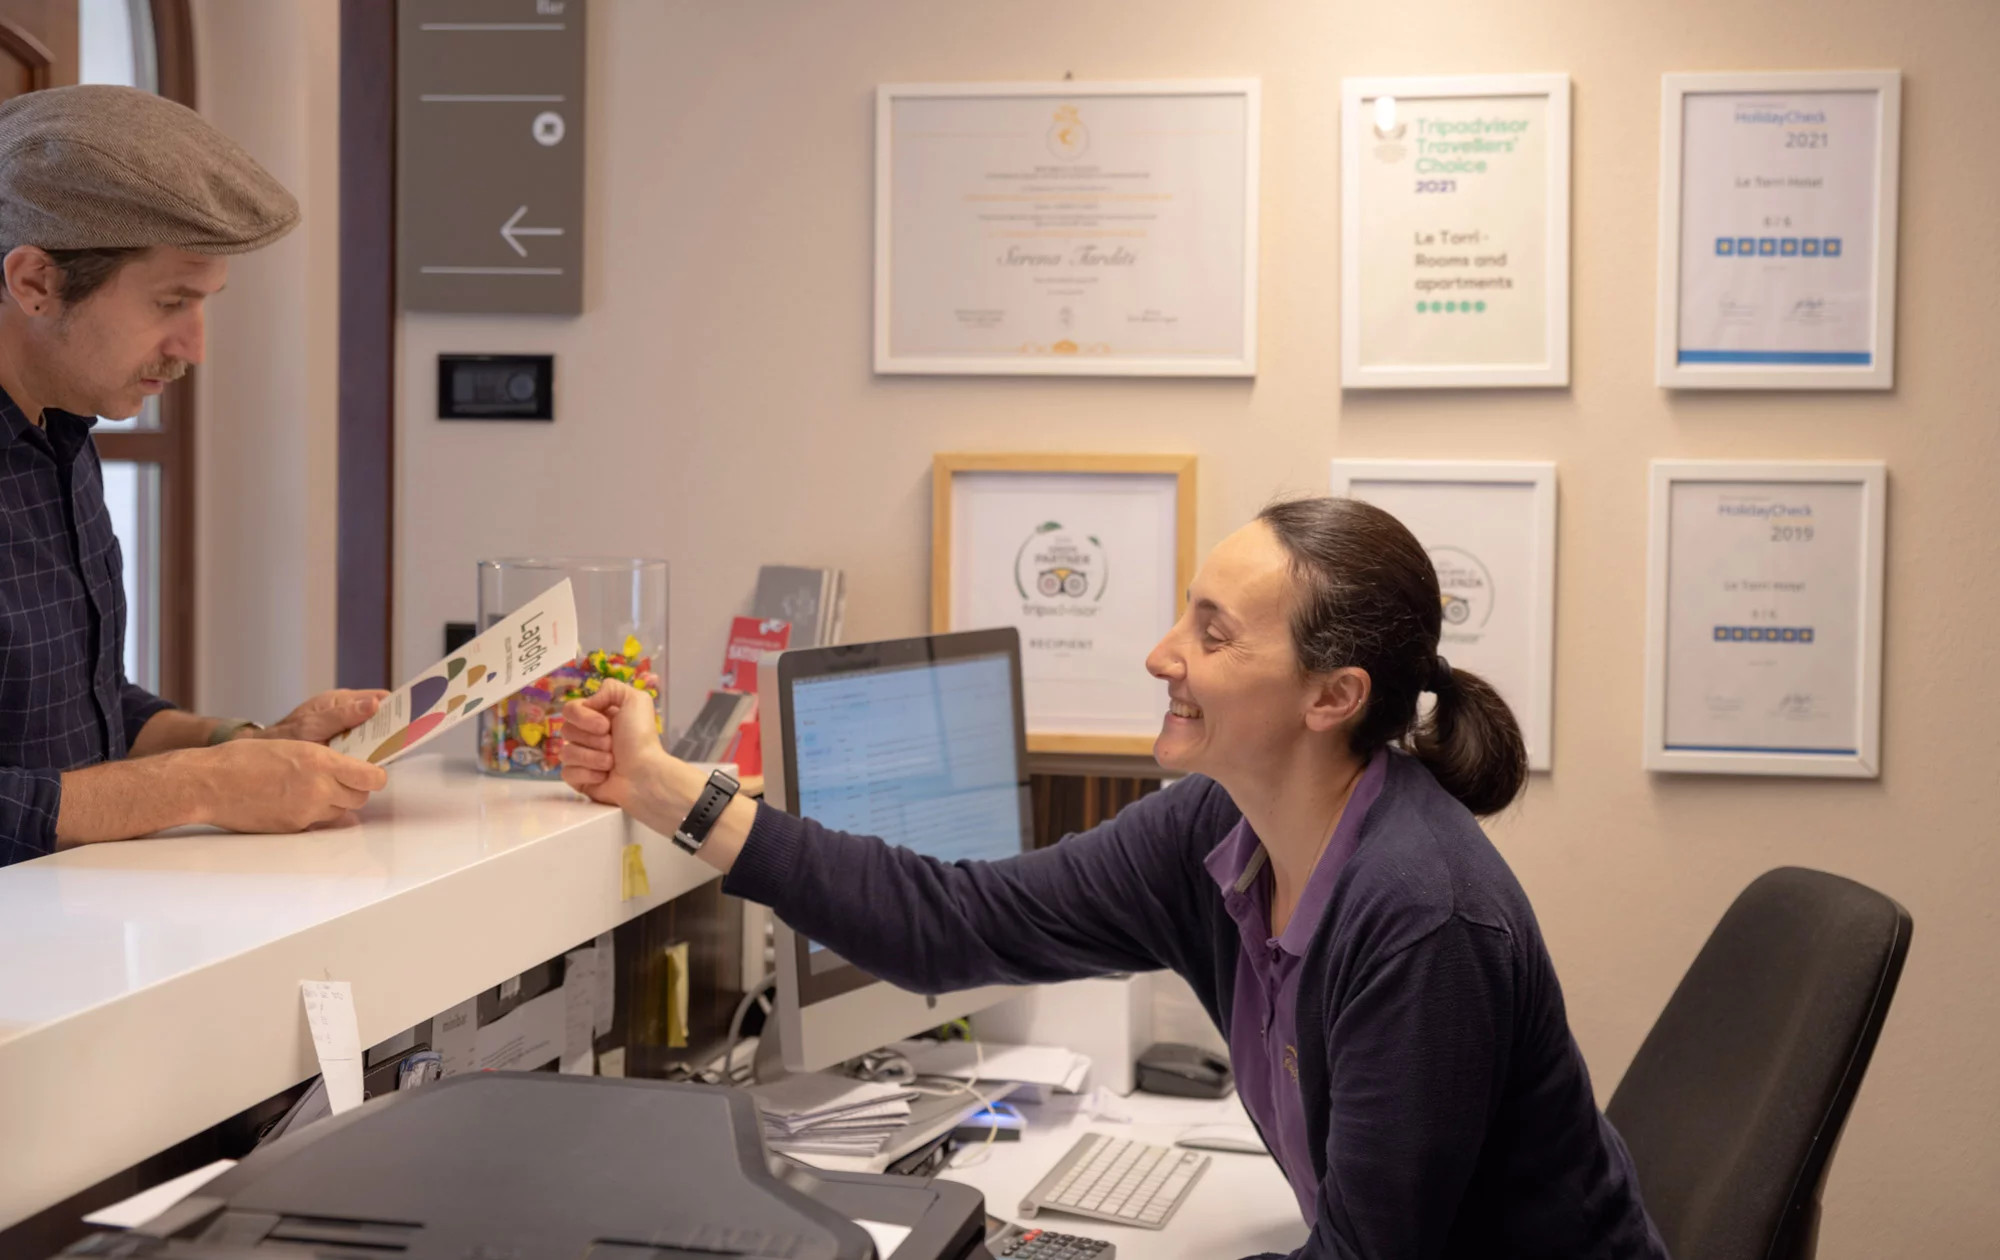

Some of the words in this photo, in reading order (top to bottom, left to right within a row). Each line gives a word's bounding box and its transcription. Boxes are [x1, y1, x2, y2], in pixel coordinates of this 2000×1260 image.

[1734, 109, 1826, 126] HolidayCheck
[1416, 117, 1529, 136] Tripadvisor
[1785, 132, 1829, 148] 2021
[1415, 155, 1488, 174] Choice
[1414, 179, 1456, 193] 2021
[1414, 231, 1434, 245] Le
[1440, 231, 1480, 245] Torri
[1414, 253, 1470, 268] Rooms
[1474, 253, 1507, 268] and
[1414, 276, 1513, 293] apartments
[1718, 503, 1812, 519] HolidayCheck
[1771, 526, 1814, 542] 2019
